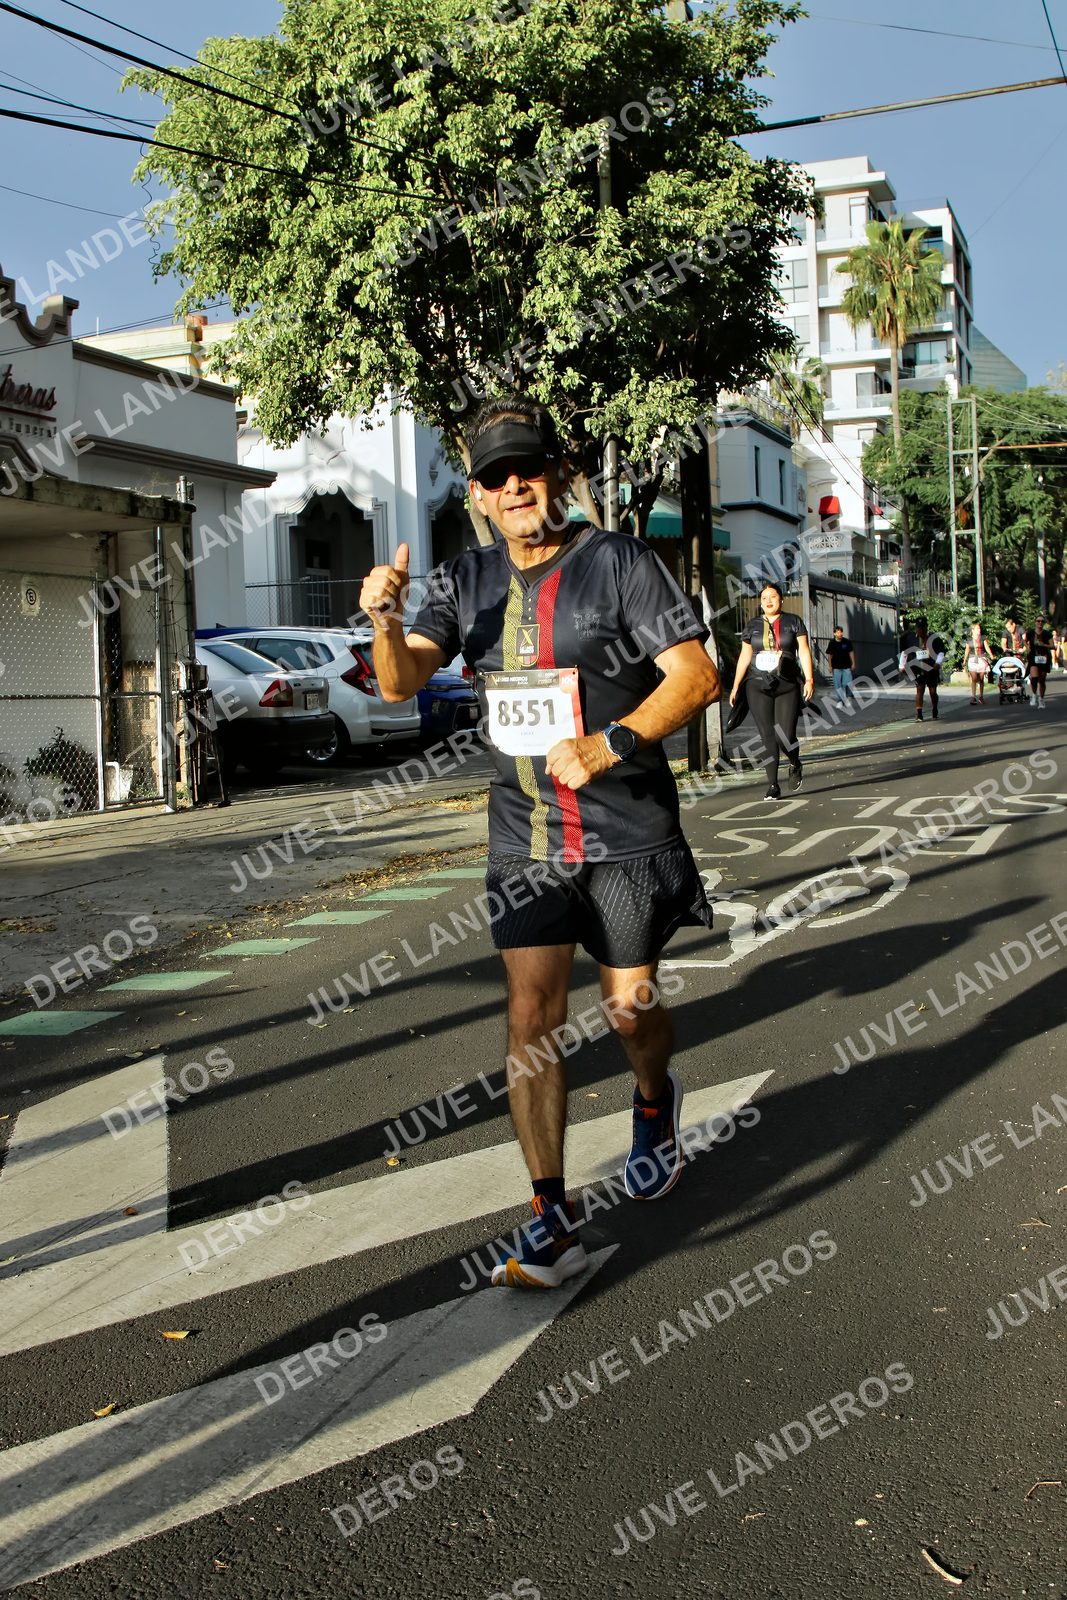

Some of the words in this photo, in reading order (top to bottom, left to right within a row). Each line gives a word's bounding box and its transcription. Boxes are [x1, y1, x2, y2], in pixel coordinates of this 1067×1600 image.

[498, 699, 555, 726] 8551
[710, 793, 1067, 821] SOLO
[692, 824, 1011, 858] BUS
